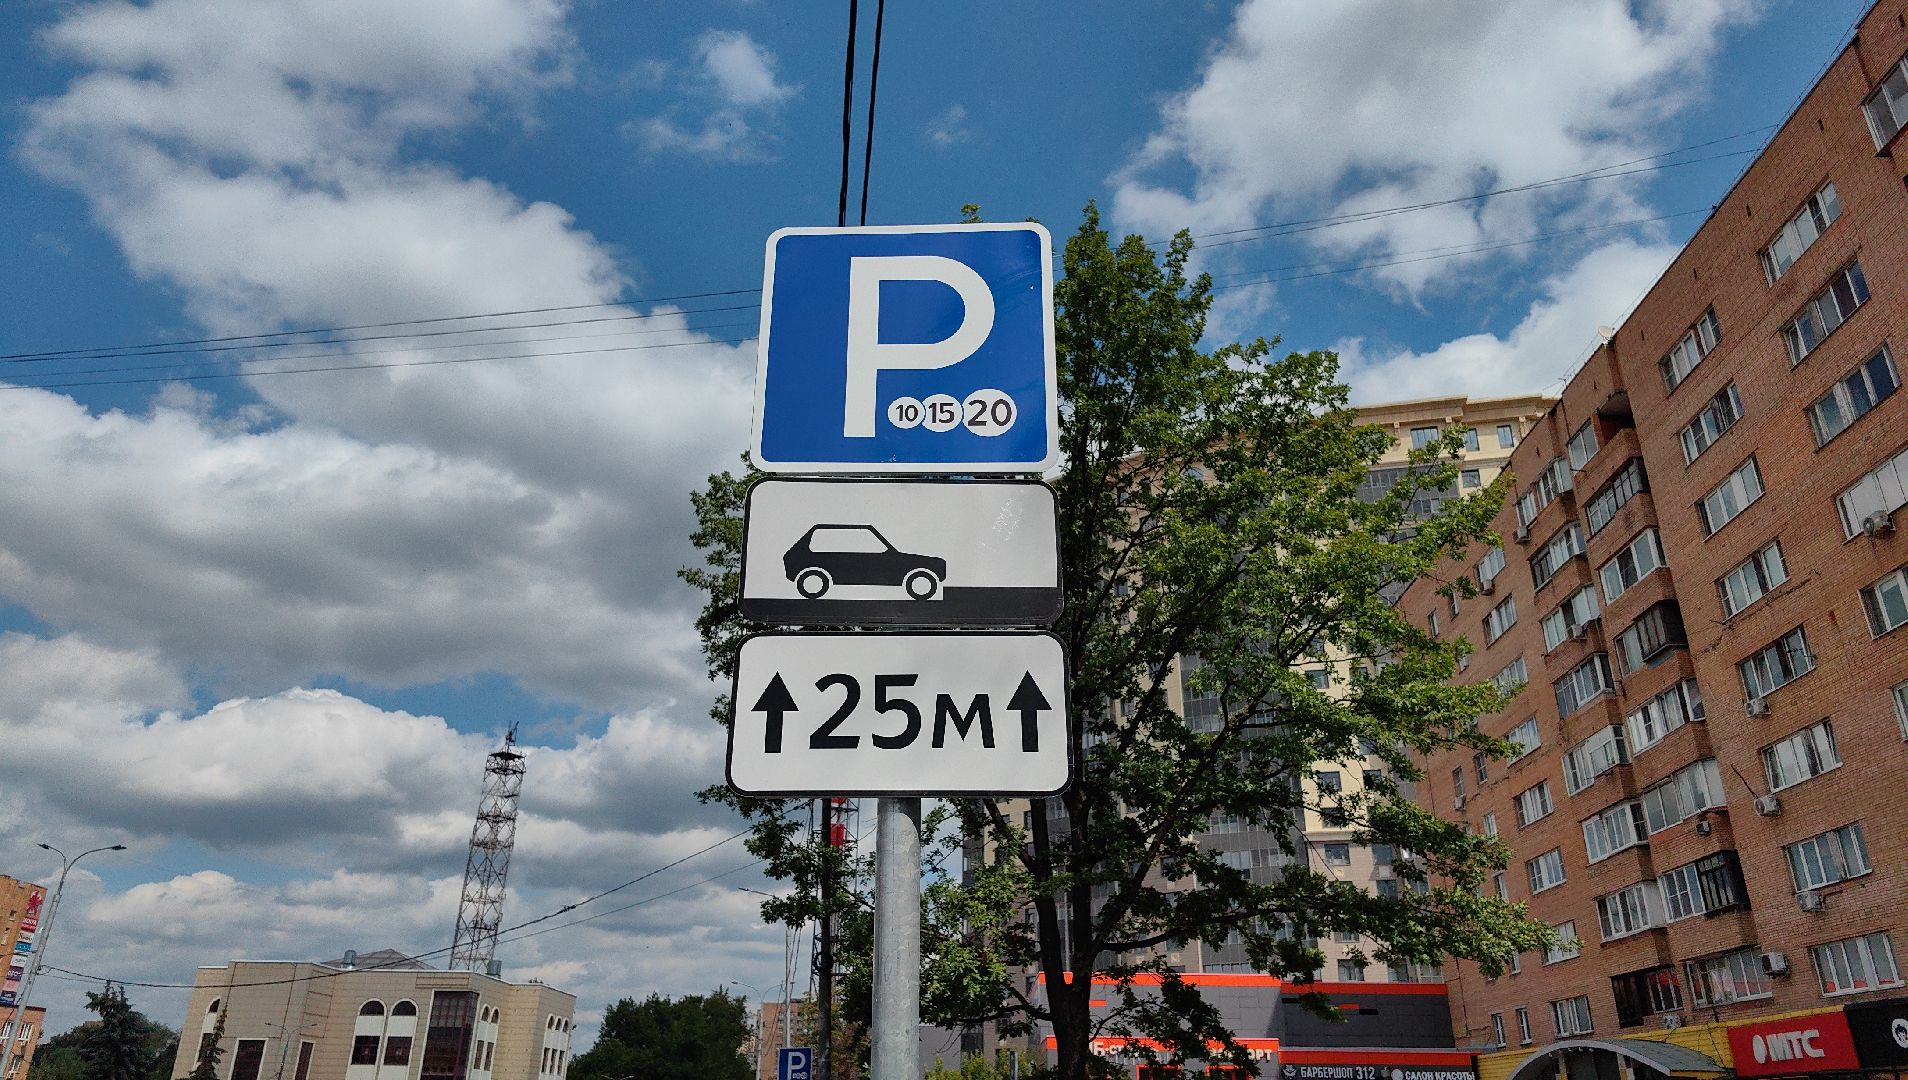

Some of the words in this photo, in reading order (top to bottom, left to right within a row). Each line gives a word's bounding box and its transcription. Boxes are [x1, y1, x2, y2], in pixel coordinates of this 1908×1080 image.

[843, 255, 996, 438] P
[895, 404, 919, 422] 10
[928, 402, 955, 424] 15
[967, 398, 1013, 427] 20
[1766, 1029, 1826, 1062] МТС
[786, 1051, 806, 1080] P
[1300, 1066, 1353, 1079] БАРБЕРШОП
[1355, 1066, 1376, 1080] 312
[1405, 1071, 1434, 1080] САЛОН
[1434, 1071, 1475, 1080] КРАСОТЫ
